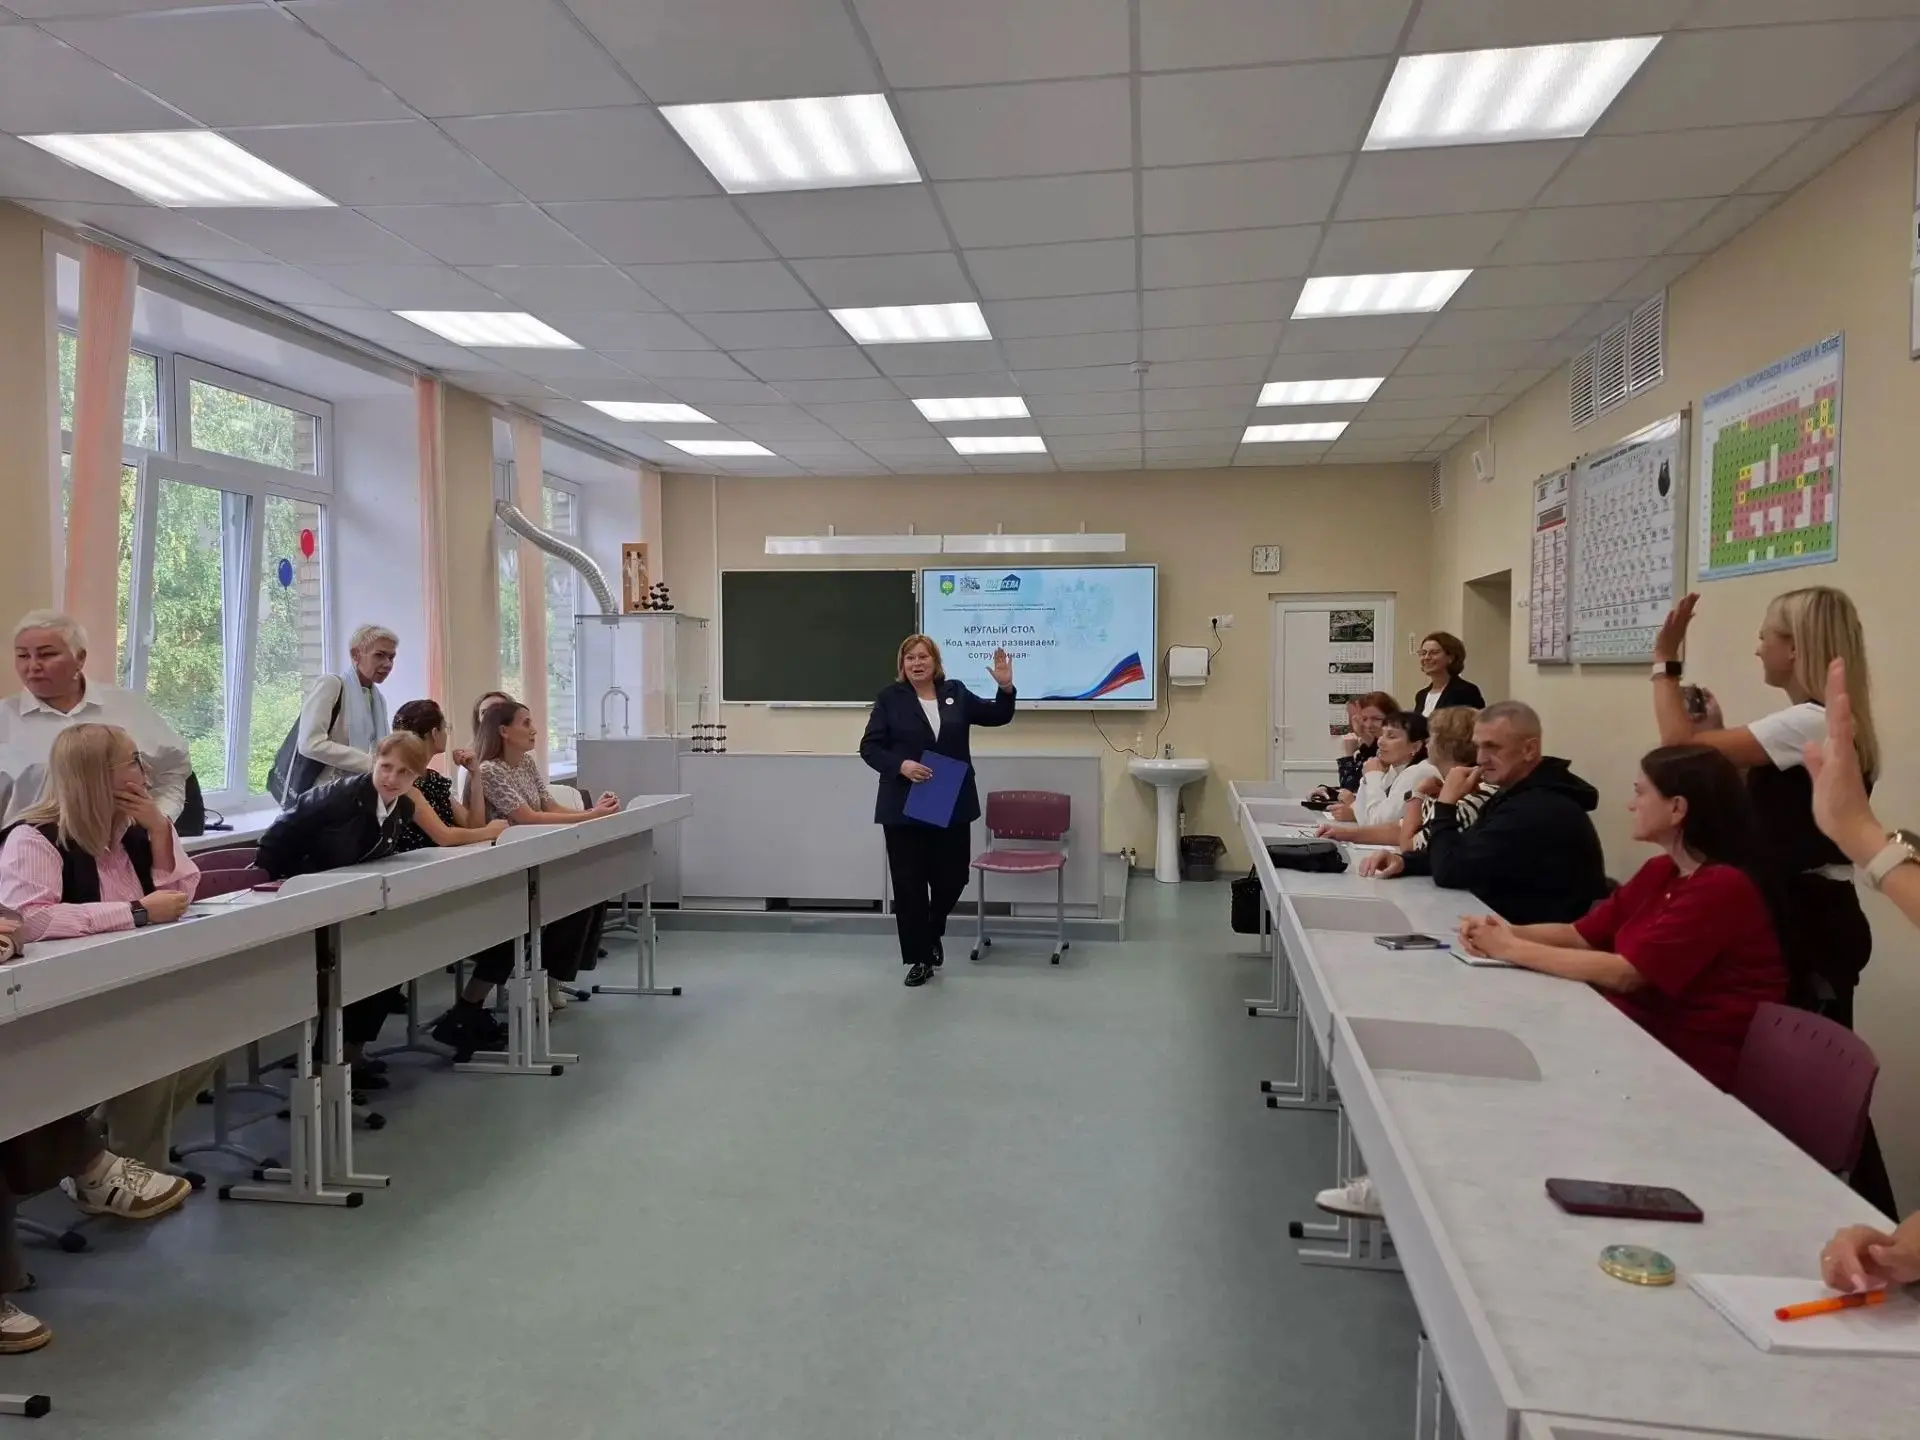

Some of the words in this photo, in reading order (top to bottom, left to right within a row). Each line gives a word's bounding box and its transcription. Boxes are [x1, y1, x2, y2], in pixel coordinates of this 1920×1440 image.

[964, 625, 1008, 634] КРУГЛЫЙ
[1010, 625, 1035, 634] СТОЛ
[965, 639, 999, 647] кадета:
